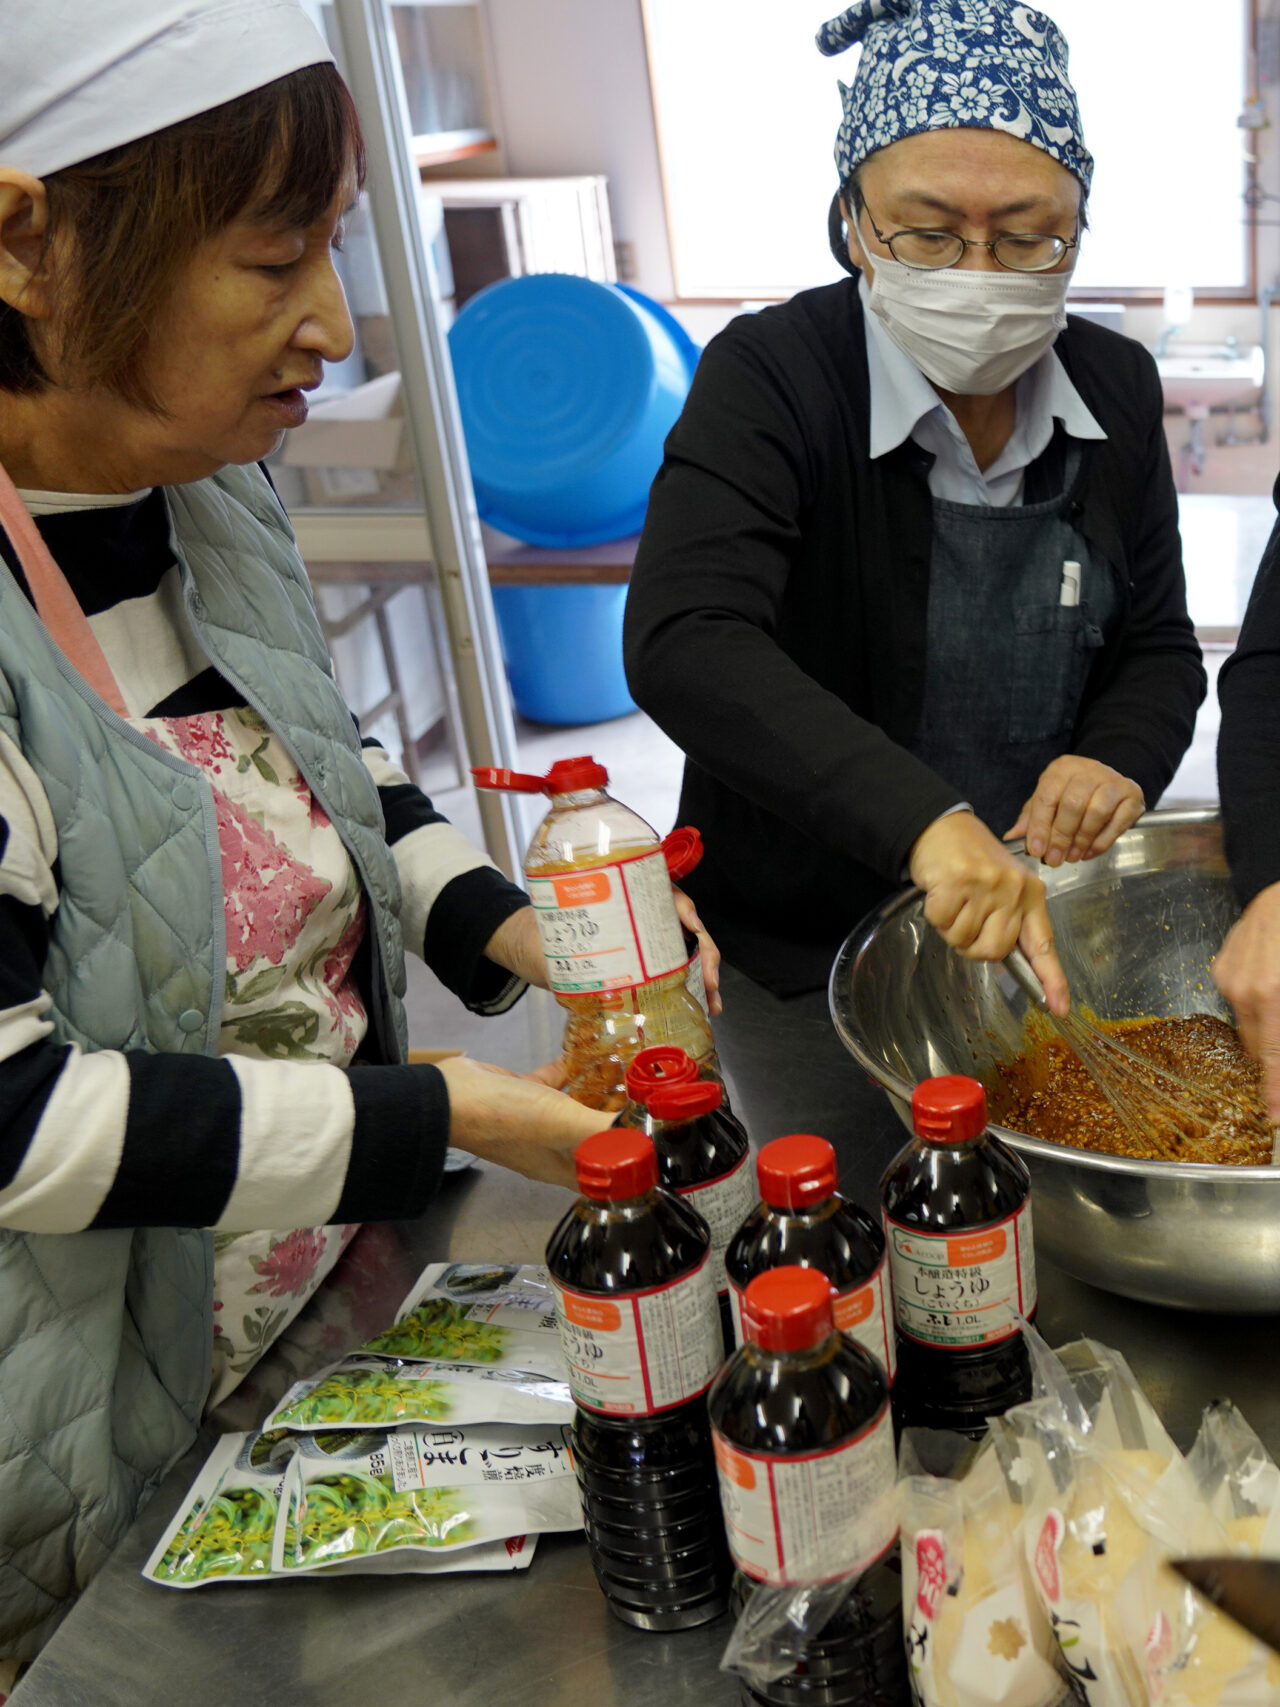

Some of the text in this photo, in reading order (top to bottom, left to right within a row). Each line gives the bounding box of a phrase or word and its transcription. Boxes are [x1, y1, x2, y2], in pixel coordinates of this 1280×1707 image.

[914, 1276, 990, 1299] しょうゆ
[423, 1429, 465, 1448] (白)
[369, 1452, 385, 1476] 85g
[423, 1441, 565, 1469] すりごま
[481, 1459, 567, 1481] 二度焙煎
